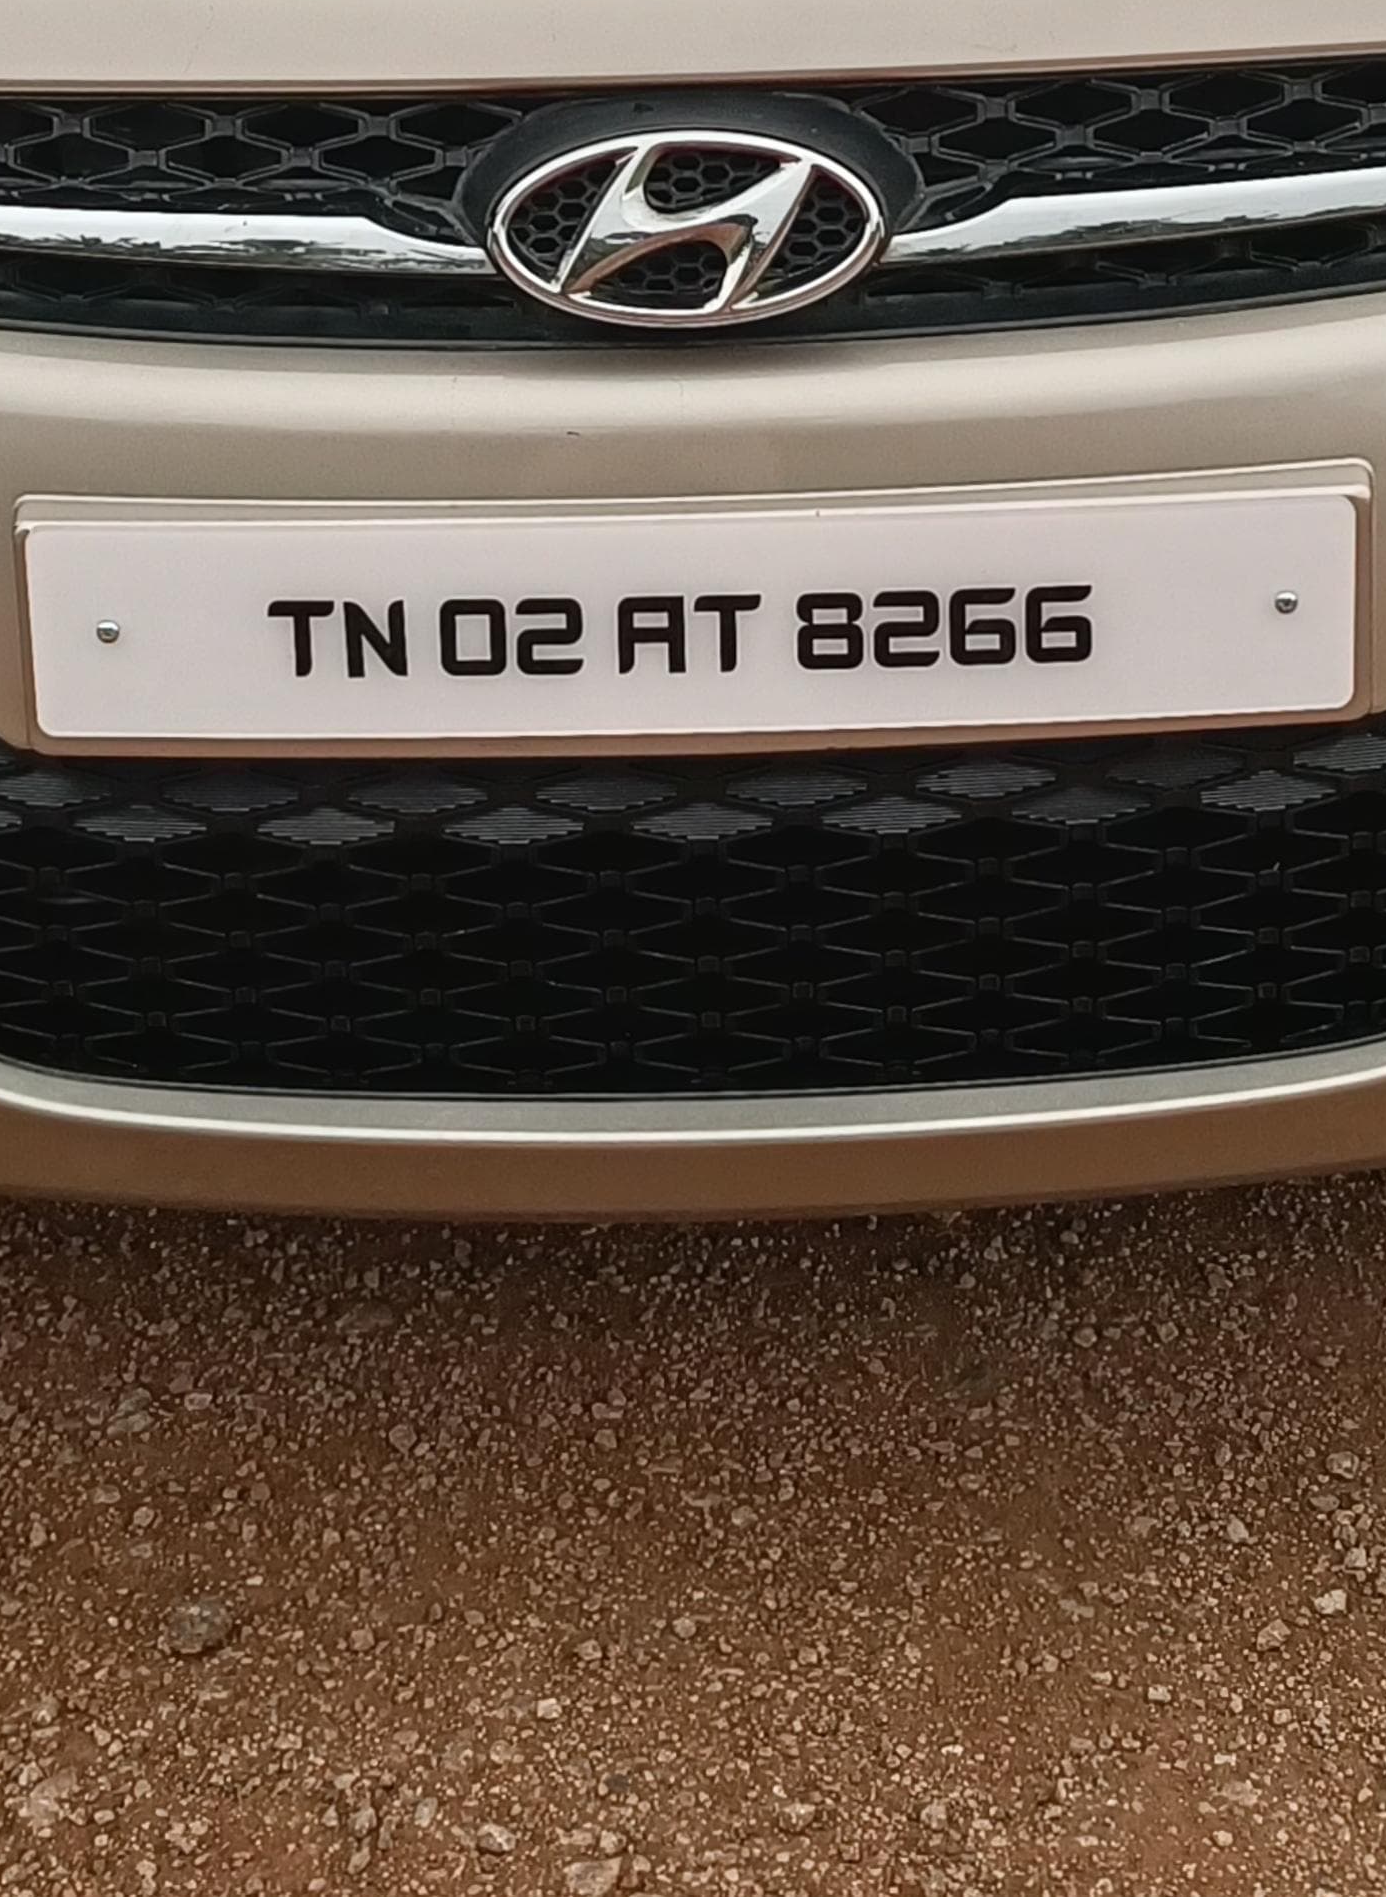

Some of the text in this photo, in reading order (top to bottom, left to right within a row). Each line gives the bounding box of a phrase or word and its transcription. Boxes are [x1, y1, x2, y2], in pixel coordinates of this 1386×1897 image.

[267, 584, 1094, 679] TN 02 AT 8266
